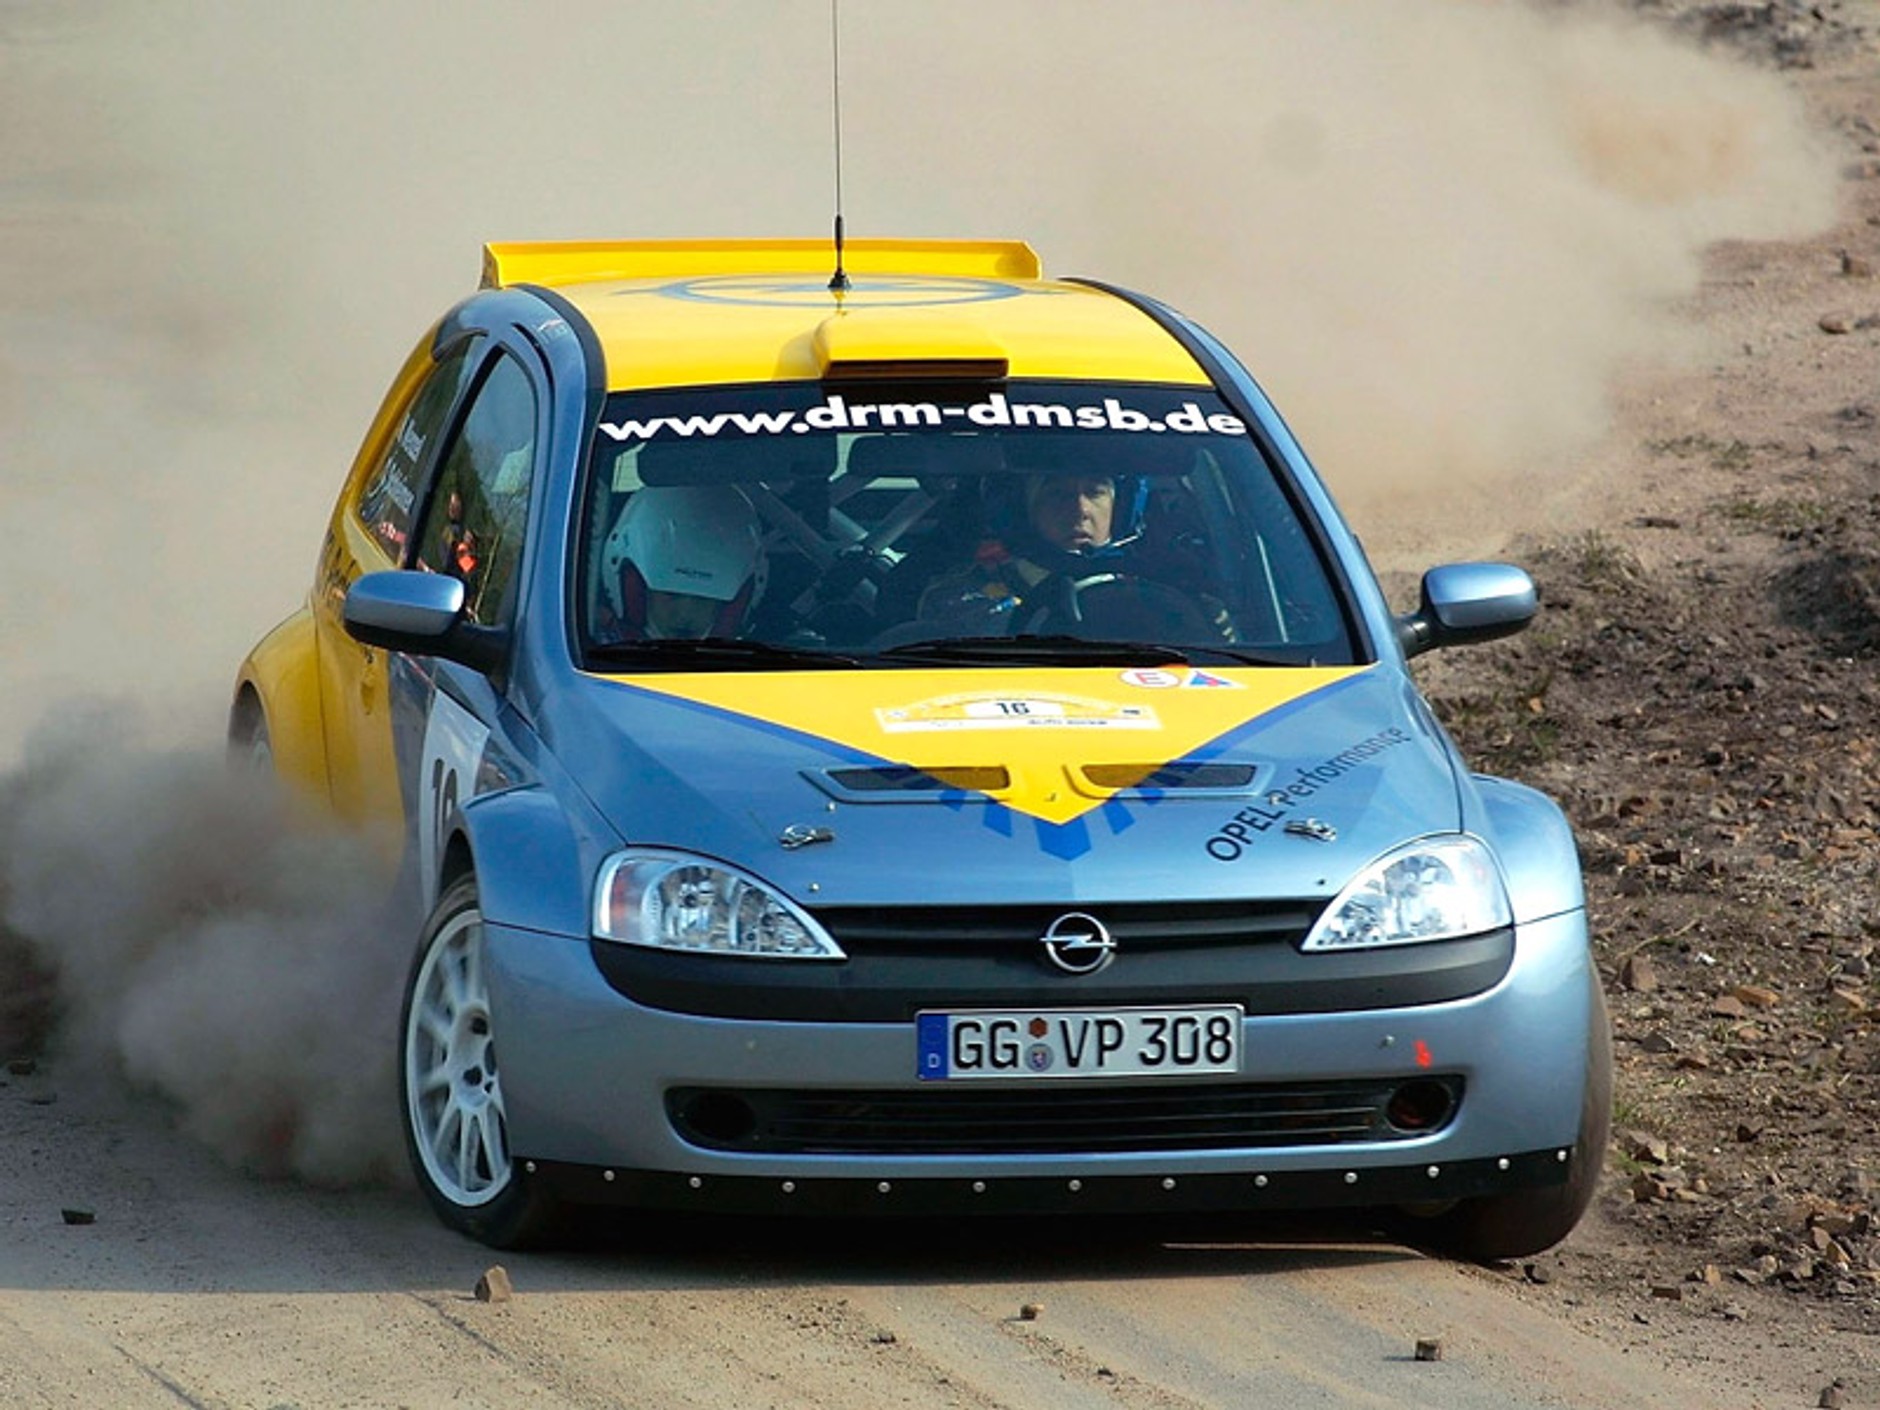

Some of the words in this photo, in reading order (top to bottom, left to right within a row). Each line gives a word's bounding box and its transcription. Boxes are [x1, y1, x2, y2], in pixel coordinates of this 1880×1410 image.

[600, 394, 1247, 441] www.drm-dmsb.de
[996, 702, 1030, 715] 16
[1205, 806, 1286, 861] OPEL
[1264, 726, 1411, 806] Performance
[953, 1021, 1019, 1069] GG
[1059, 1018, 1124, 1068] VP
[1138, 1015, 1233, 1065] 308
